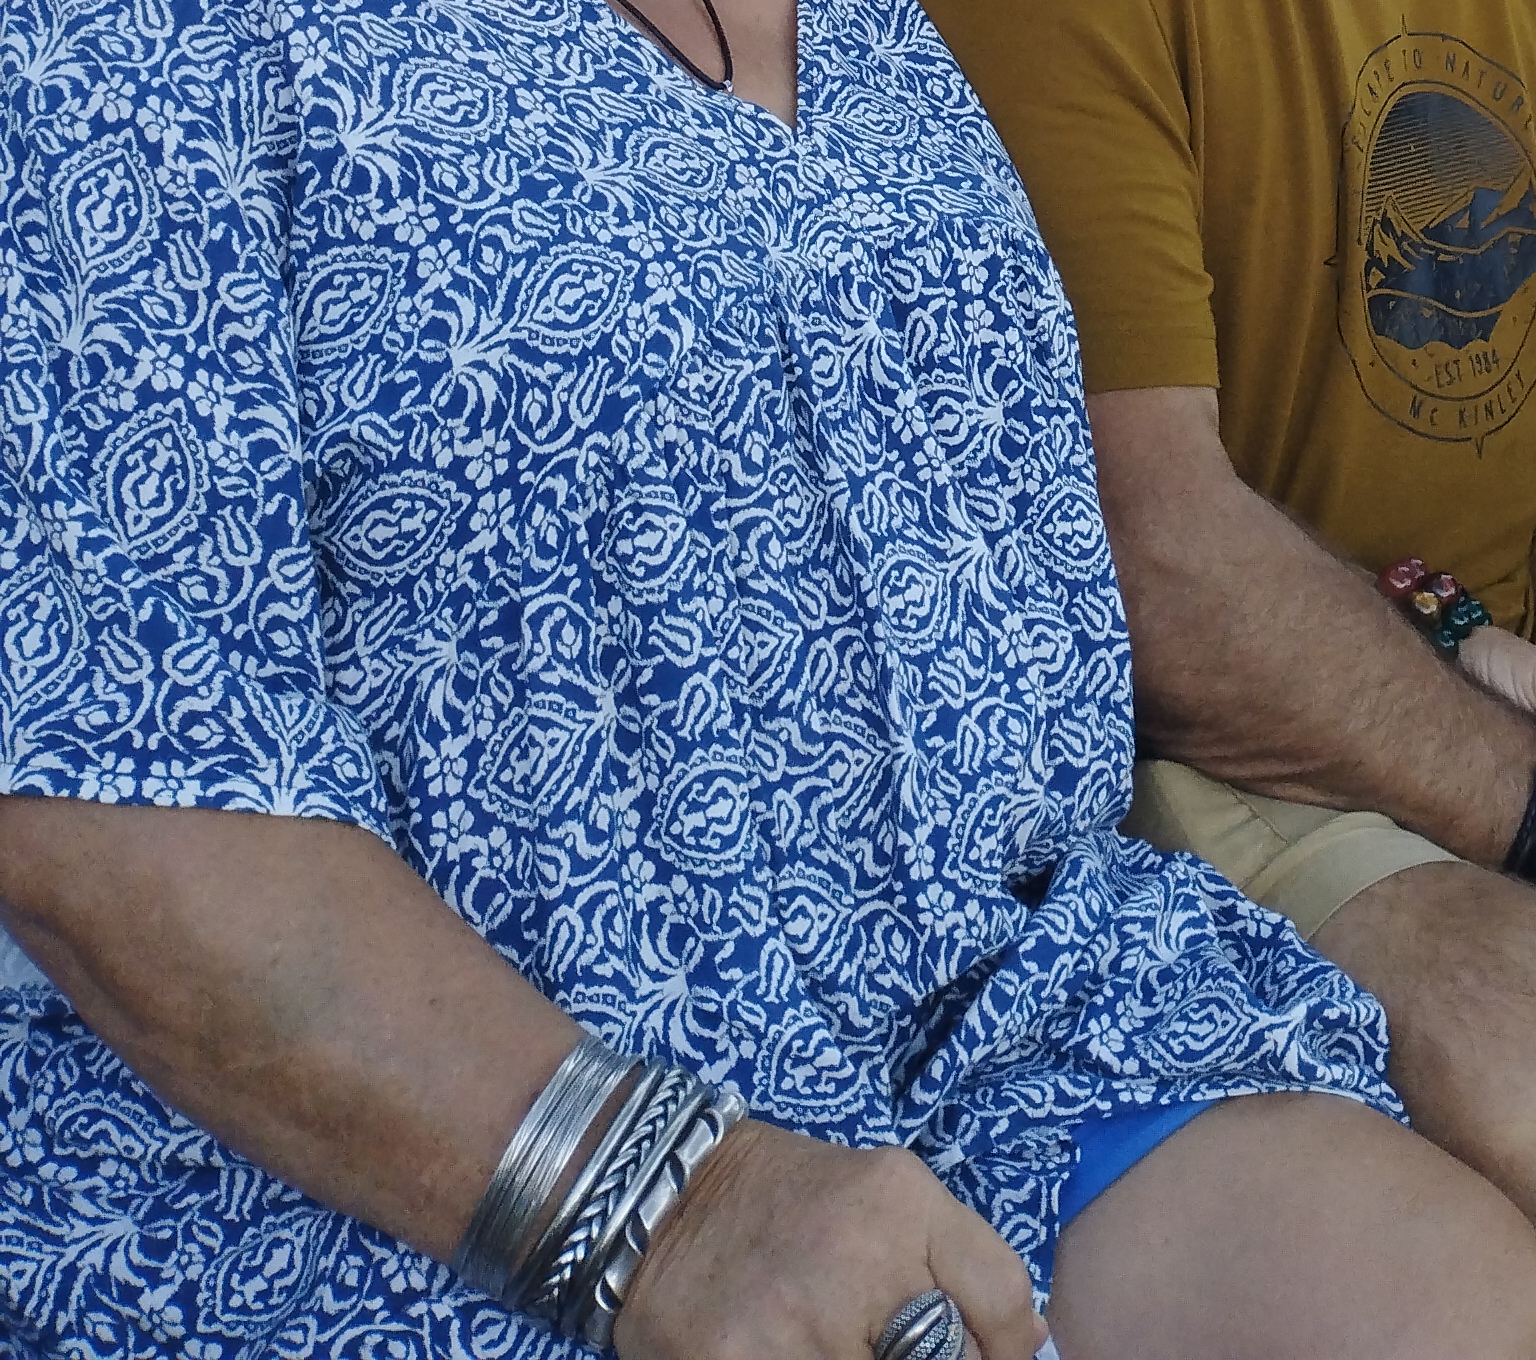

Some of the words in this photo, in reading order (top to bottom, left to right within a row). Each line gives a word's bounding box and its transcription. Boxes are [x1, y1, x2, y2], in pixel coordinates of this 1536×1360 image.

[1433, 359, 1463, 389] EST
[1468, 347, 1500, 378] 1984
[1457, 368, 1526, 430] KINLEY
